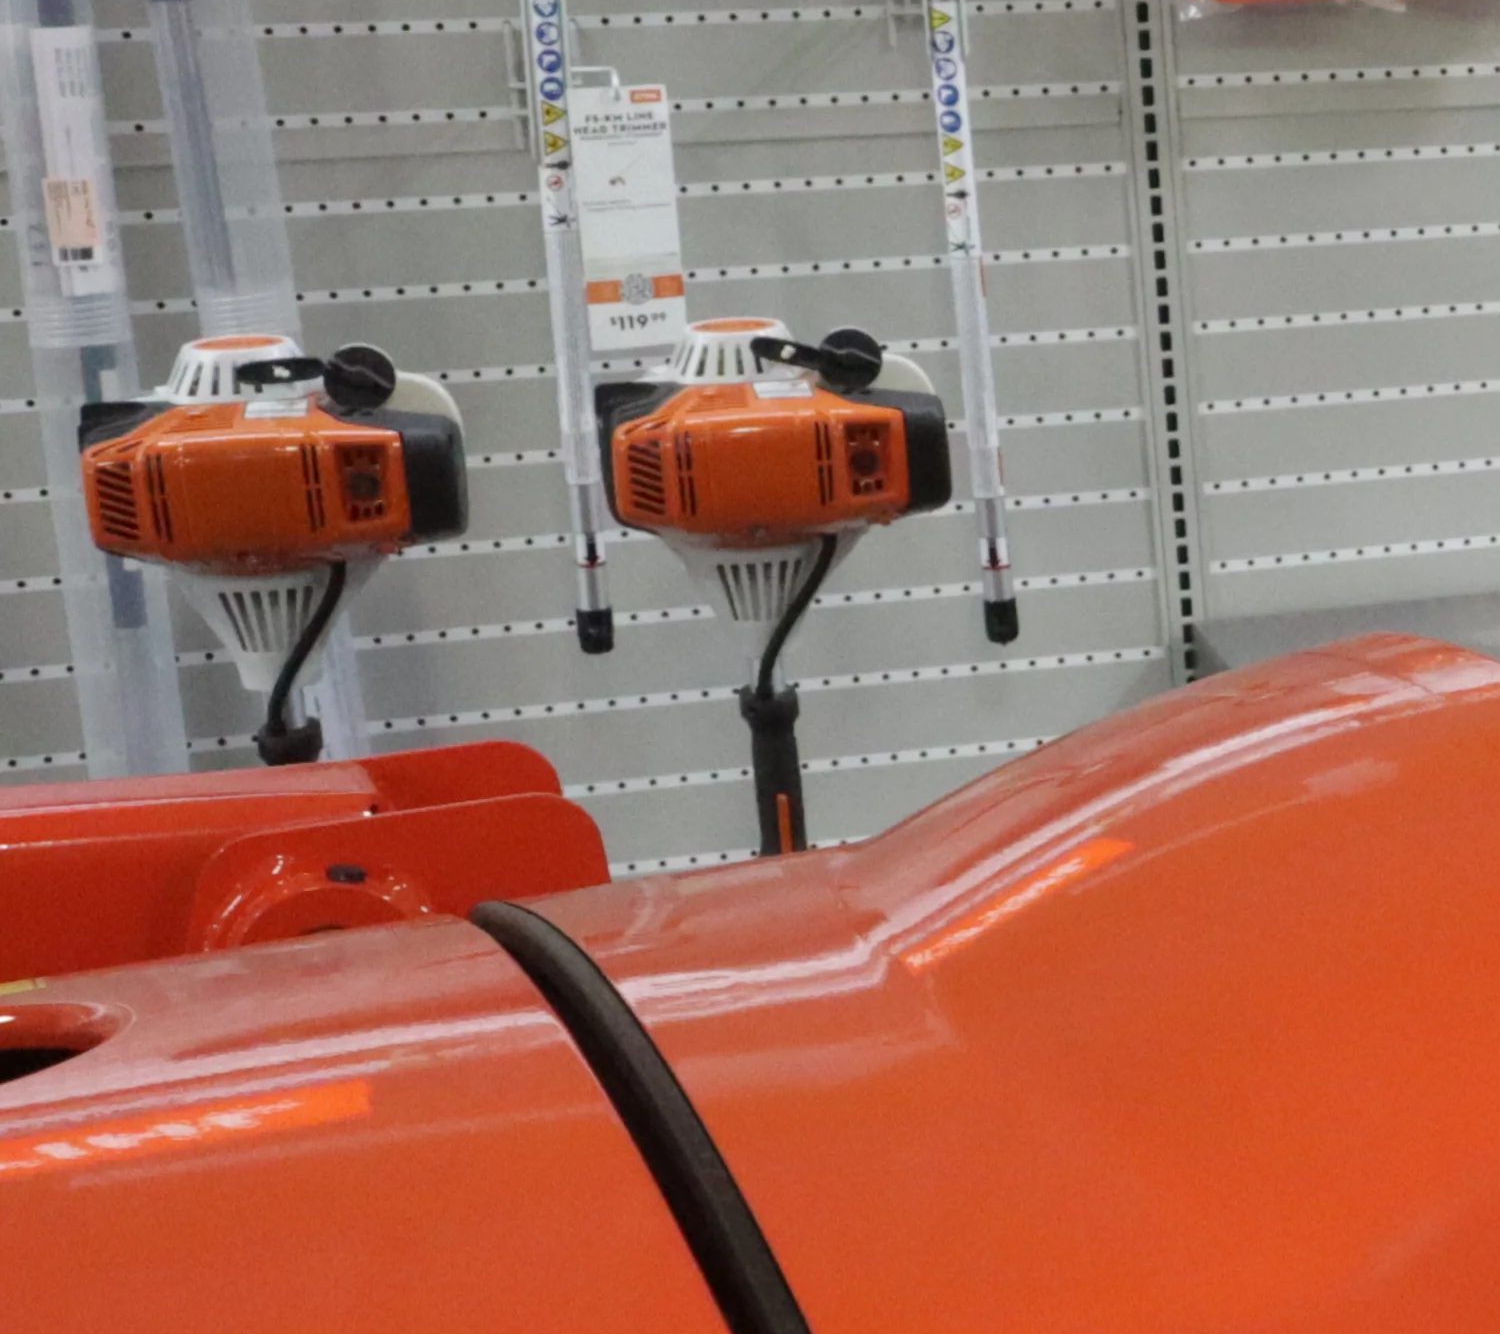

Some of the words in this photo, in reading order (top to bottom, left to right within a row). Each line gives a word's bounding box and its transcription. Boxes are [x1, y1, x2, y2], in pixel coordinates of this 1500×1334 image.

[626, 111, 654, 122] LINE
[574, 124, 608, 135] HEAD
[612, 122, 667, 134] TRIMMER
